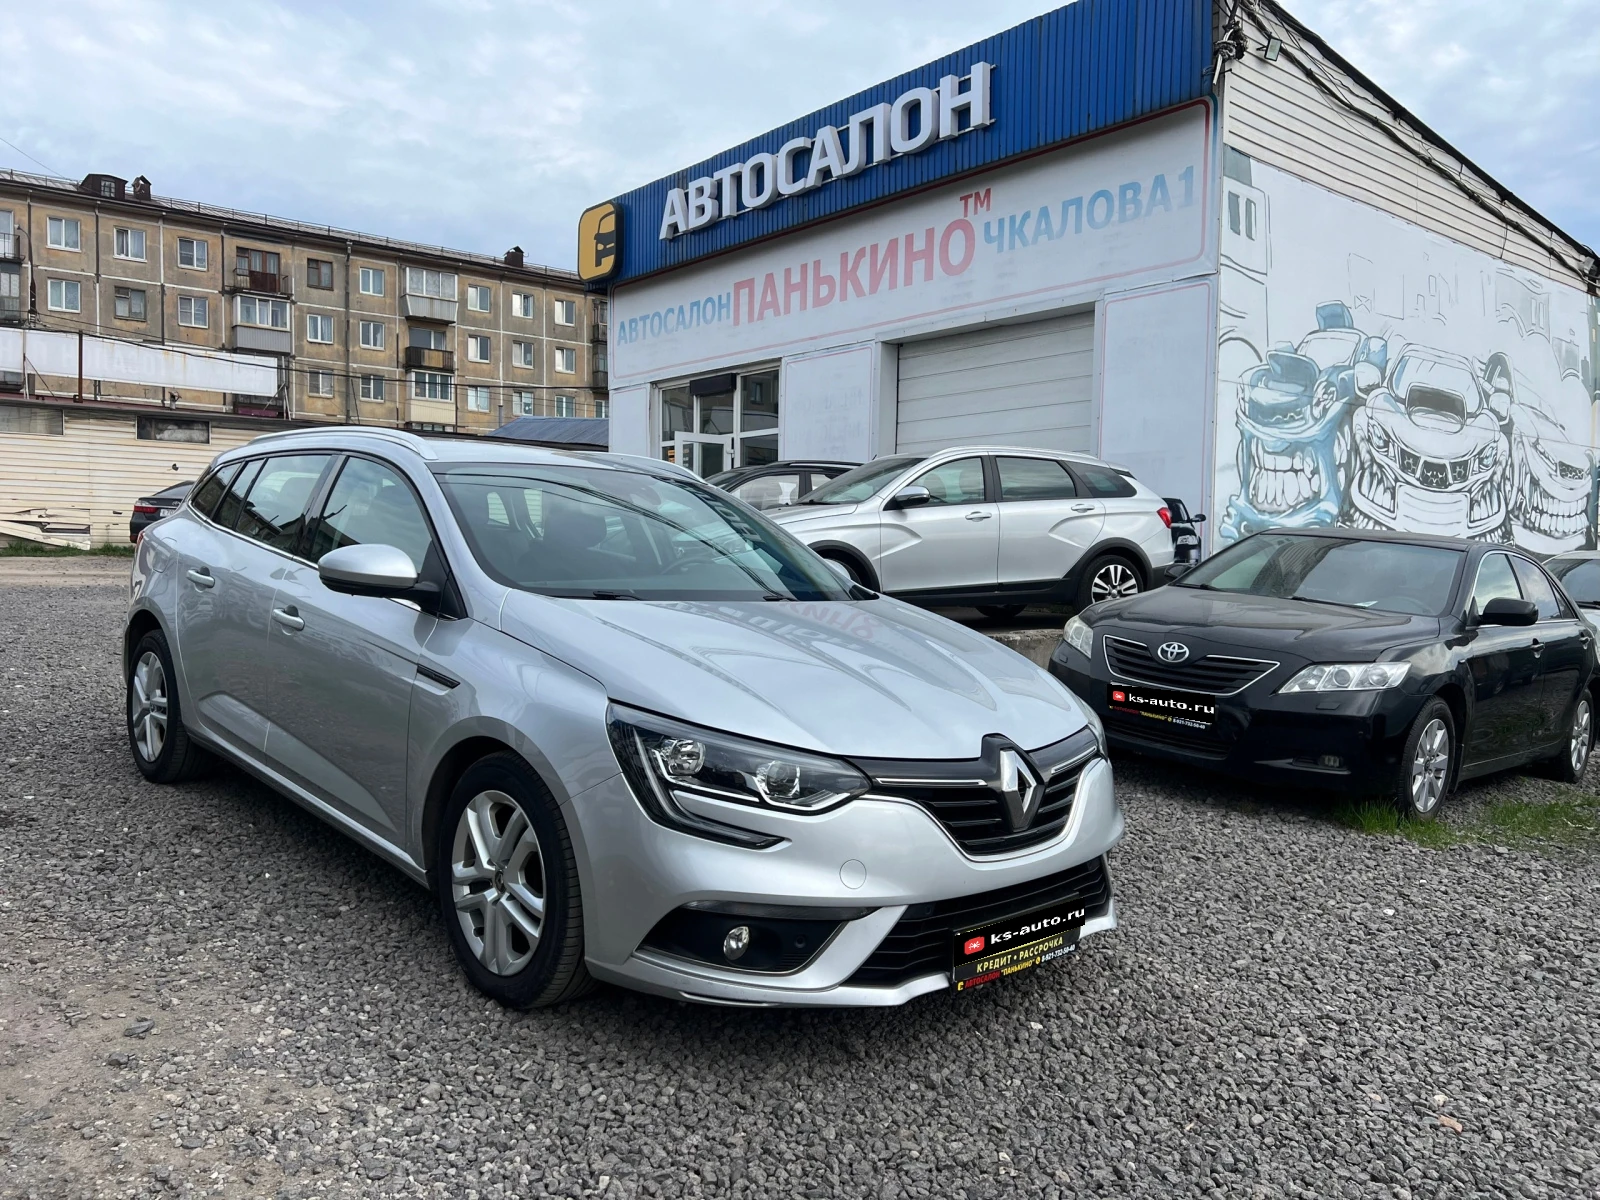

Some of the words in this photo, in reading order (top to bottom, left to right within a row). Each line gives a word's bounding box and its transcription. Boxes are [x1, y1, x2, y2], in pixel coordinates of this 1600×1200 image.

[660, 61, 992, 241] АВТОСАЛОН
[616, 292, 731, 346] АВТОСАЛОН
[733, 218, 976, 327] ПАНЬКИНО
[965, 969, 1001, 989] АВТОСАЛОН
[976, 954, 1012, 974] КРЕДИТ
[1019, 936, 1064, 961] РАССРОЧКА
